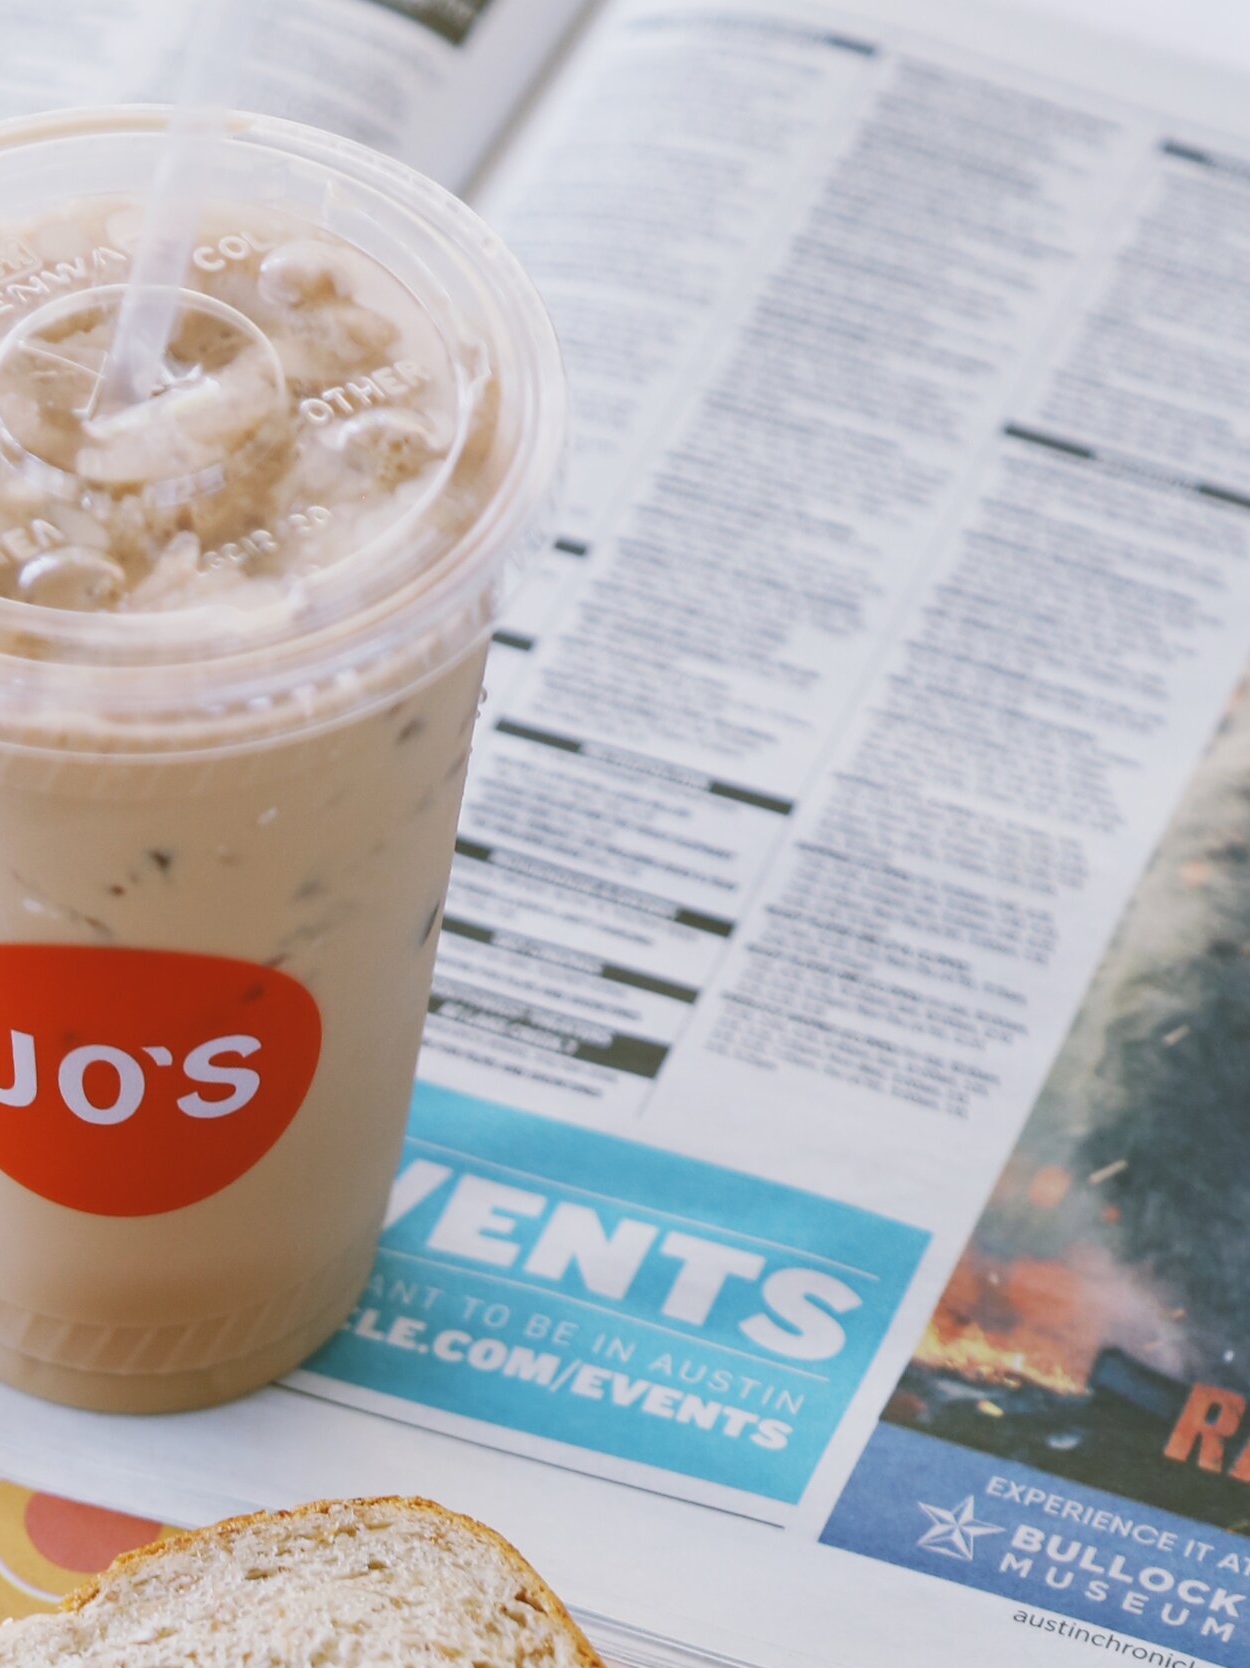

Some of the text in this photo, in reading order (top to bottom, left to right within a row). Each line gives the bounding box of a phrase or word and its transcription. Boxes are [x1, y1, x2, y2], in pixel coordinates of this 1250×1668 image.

[299, 359, 431, 425] OTHER
[382, 1157, 863, 1362] VENTS
[352, 1310, 793, 1452] LE.COM/EVENTS
[366, 1272, 805, 1415] ANT TO BE IN AUSTIN
[1163, 1381, 1250, 1485] R
[985, 1476, 1179, 1552] EXPERIENCE
[1183, 1538, 1215, 1562] IT
[1000, 1552, 1236, 1643] MUSEUM
[1011, 1523, 1247, 1618] BULLOCK
